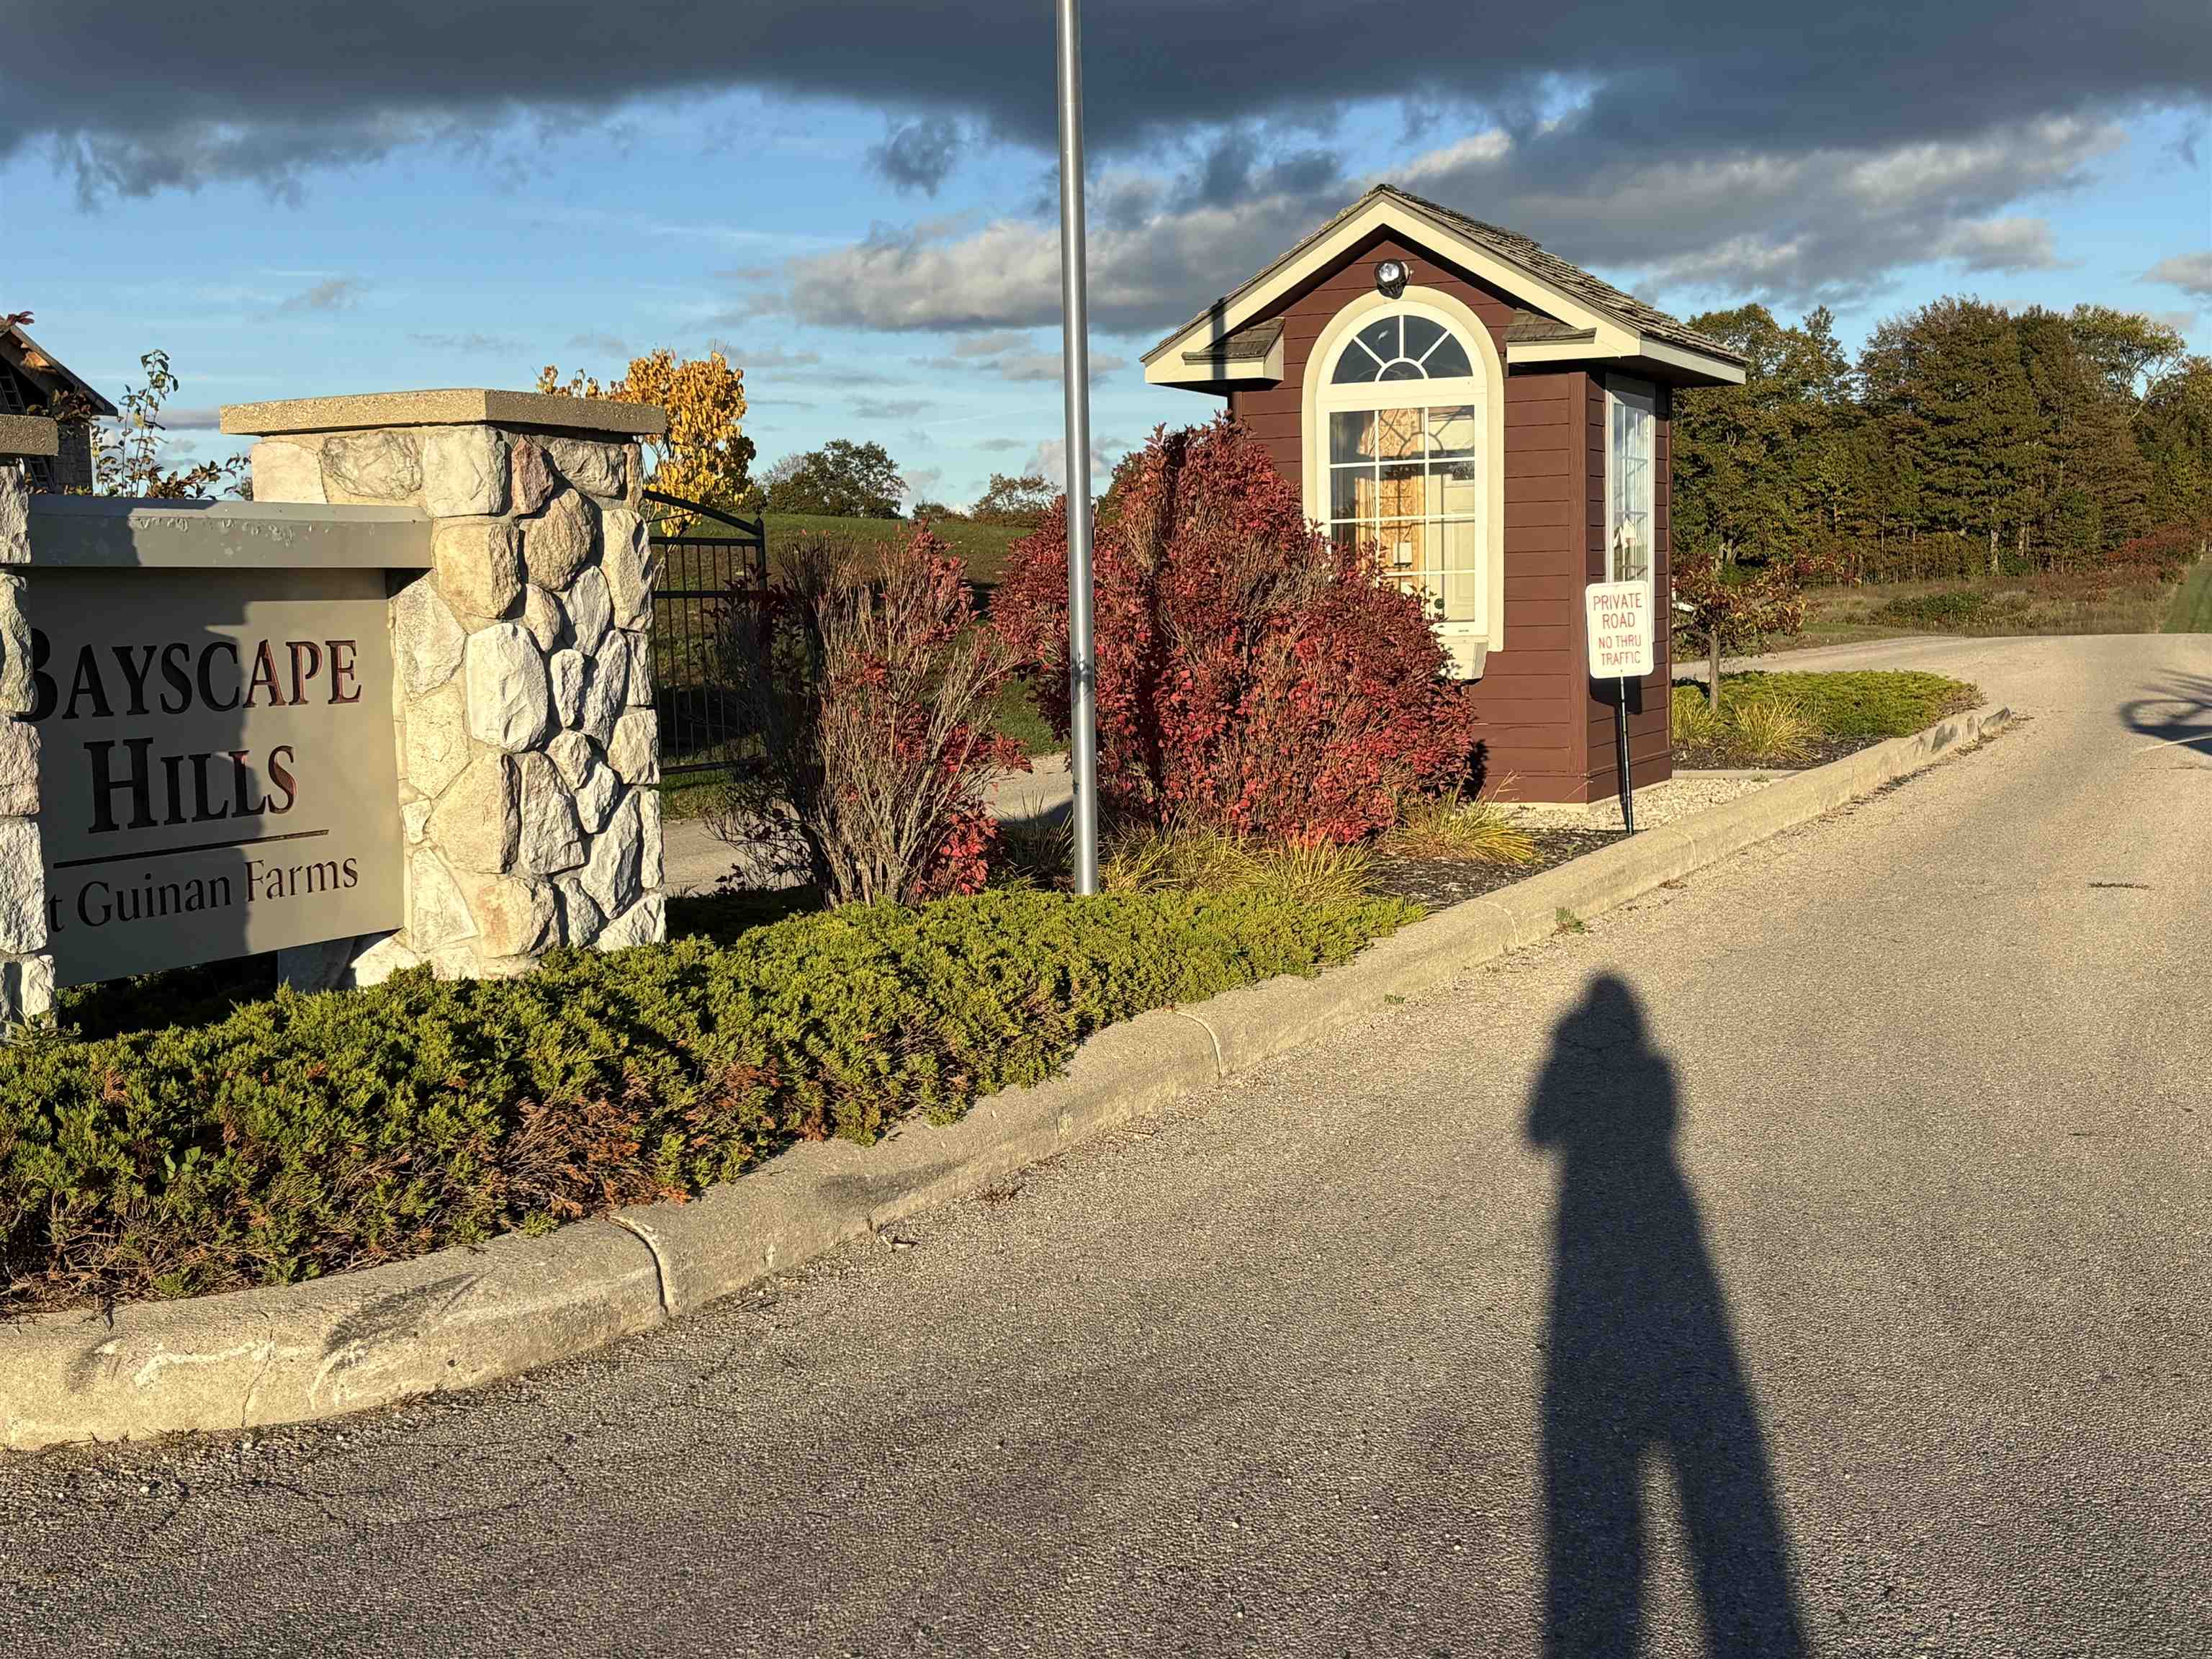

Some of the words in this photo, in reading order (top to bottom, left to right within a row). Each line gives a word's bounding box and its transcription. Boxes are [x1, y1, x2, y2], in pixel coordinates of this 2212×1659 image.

[1593, 593, 1642, 611] PRIVATE
[1602, 612, 1635, 629] ROAD
[1599, 636, 1612, 649] NO
[1615, 634, 1642, 648] THRU
[1601, 651, 1641, 665] TRAFFIC
[12, 626, 361, 722] BAYSCAPE
[83, 737, 298, 835] HILLS
[48, 893, 66, 932] t
[77, 873, 232, 927] Guinan
[245, 857, 359, 902] Farms
